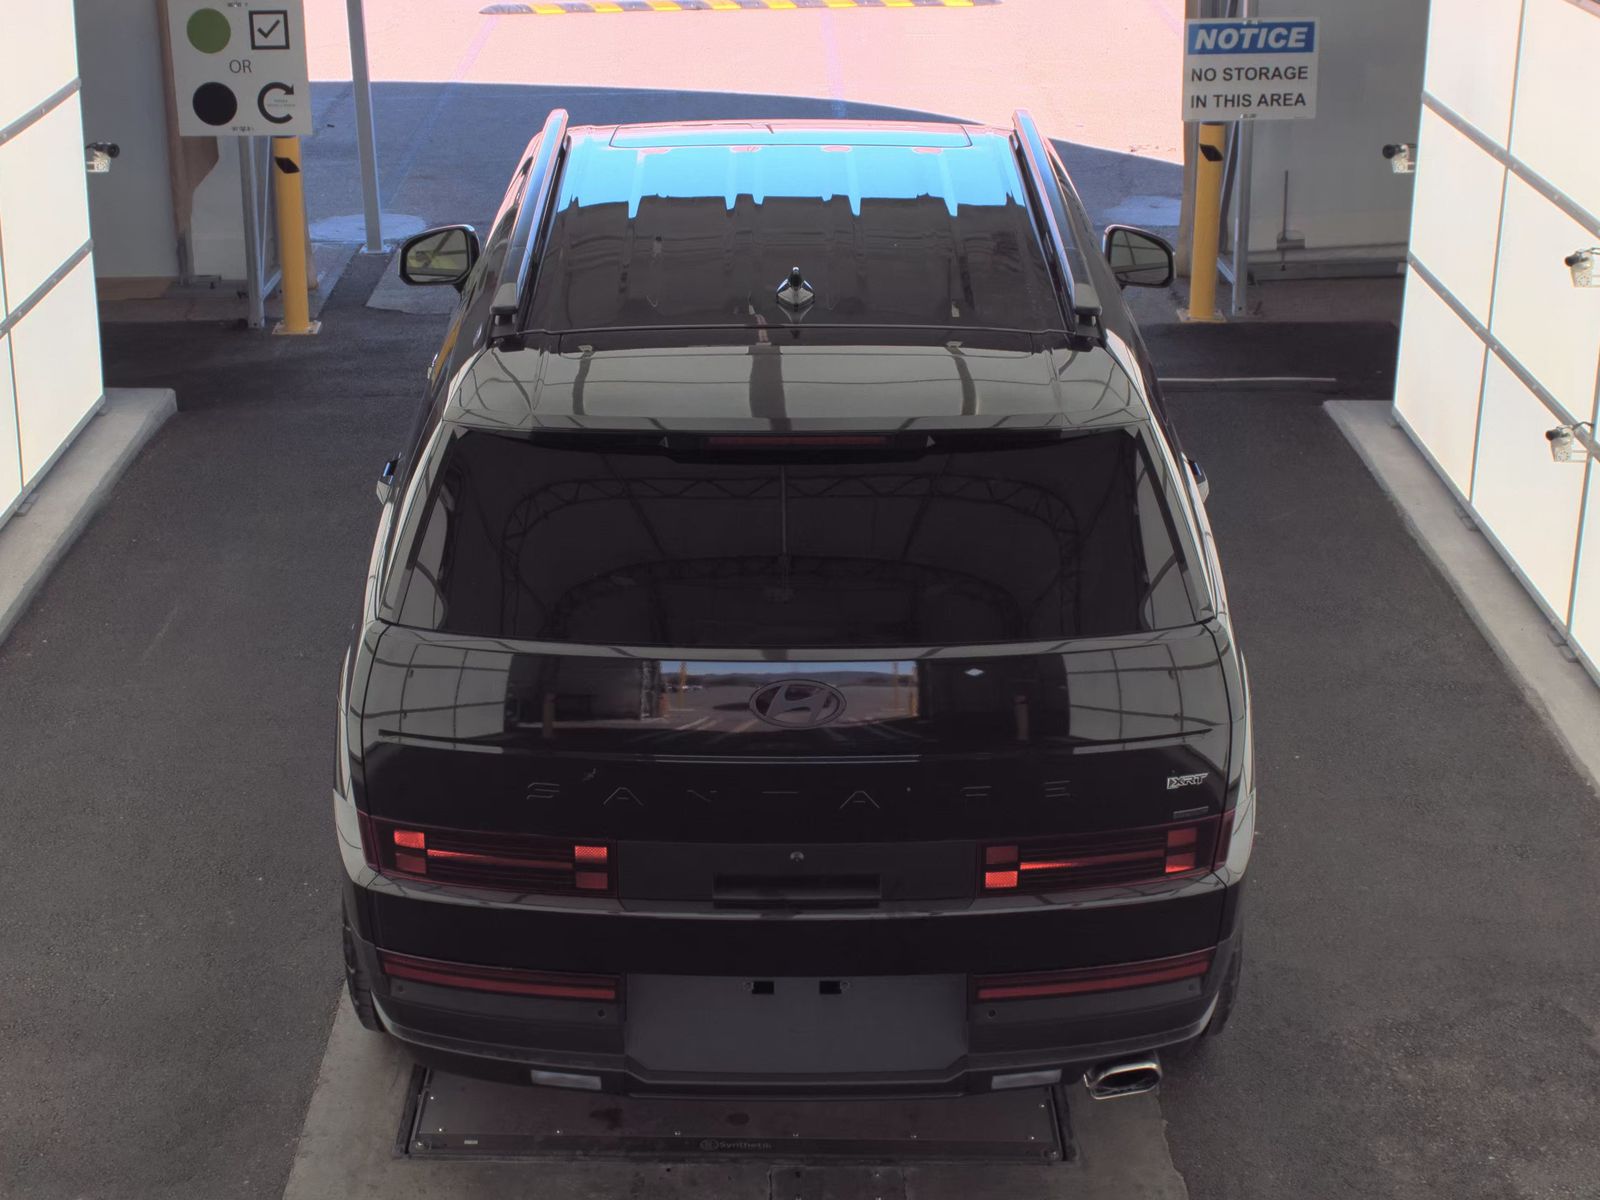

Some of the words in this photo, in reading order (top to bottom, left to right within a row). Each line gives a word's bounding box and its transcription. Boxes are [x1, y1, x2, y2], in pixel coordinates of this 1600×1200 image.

[1195, 26, 1308, 50] NOTICE
[229, 59, 252, 73] OR
[1191, 67, 1217, 82] NO
[1222, 66, 1309, 82] STORAGE
[1190, 95, 1207, 108] IN
[1213, 93, 1252, 108] THIS
[1256, 93, 1307, 107] AREA
[1167, 772, 1209, 789] XRT
